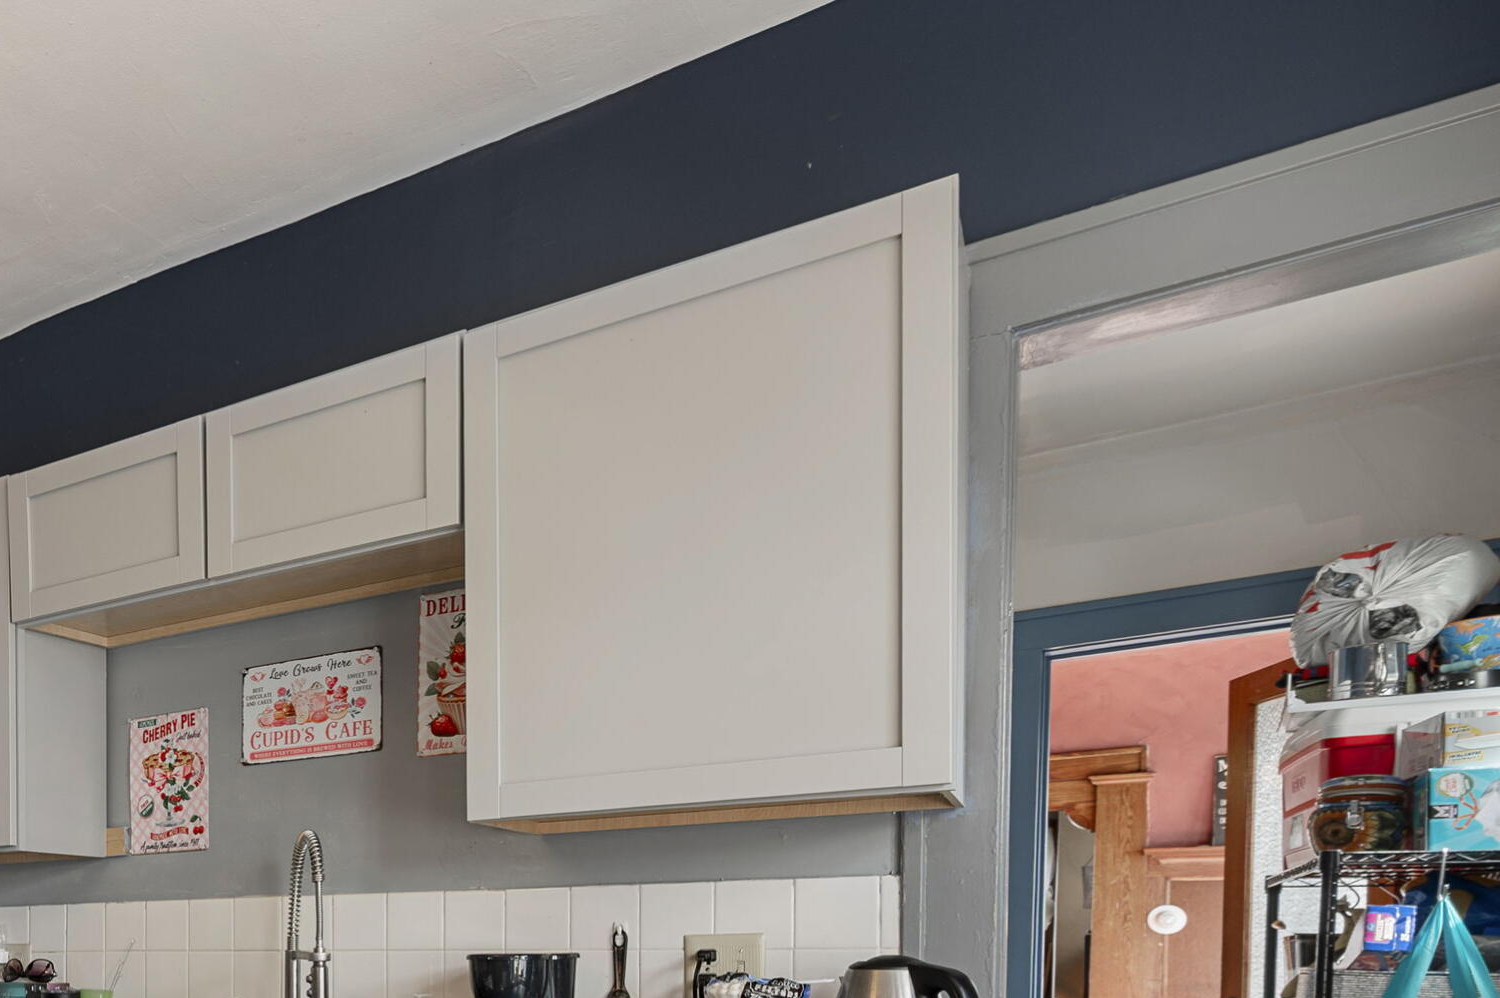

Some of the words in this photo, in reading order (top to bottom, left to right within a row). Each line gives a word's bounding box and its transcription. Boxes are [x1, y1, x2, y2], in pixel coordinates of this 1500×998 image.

[327, 658, 352, 671] Here
[142, 719, 178, 744] CHERRY
[181, 712, 196, 730] PIE
[250, 726, 315, 750] CUPID'S
